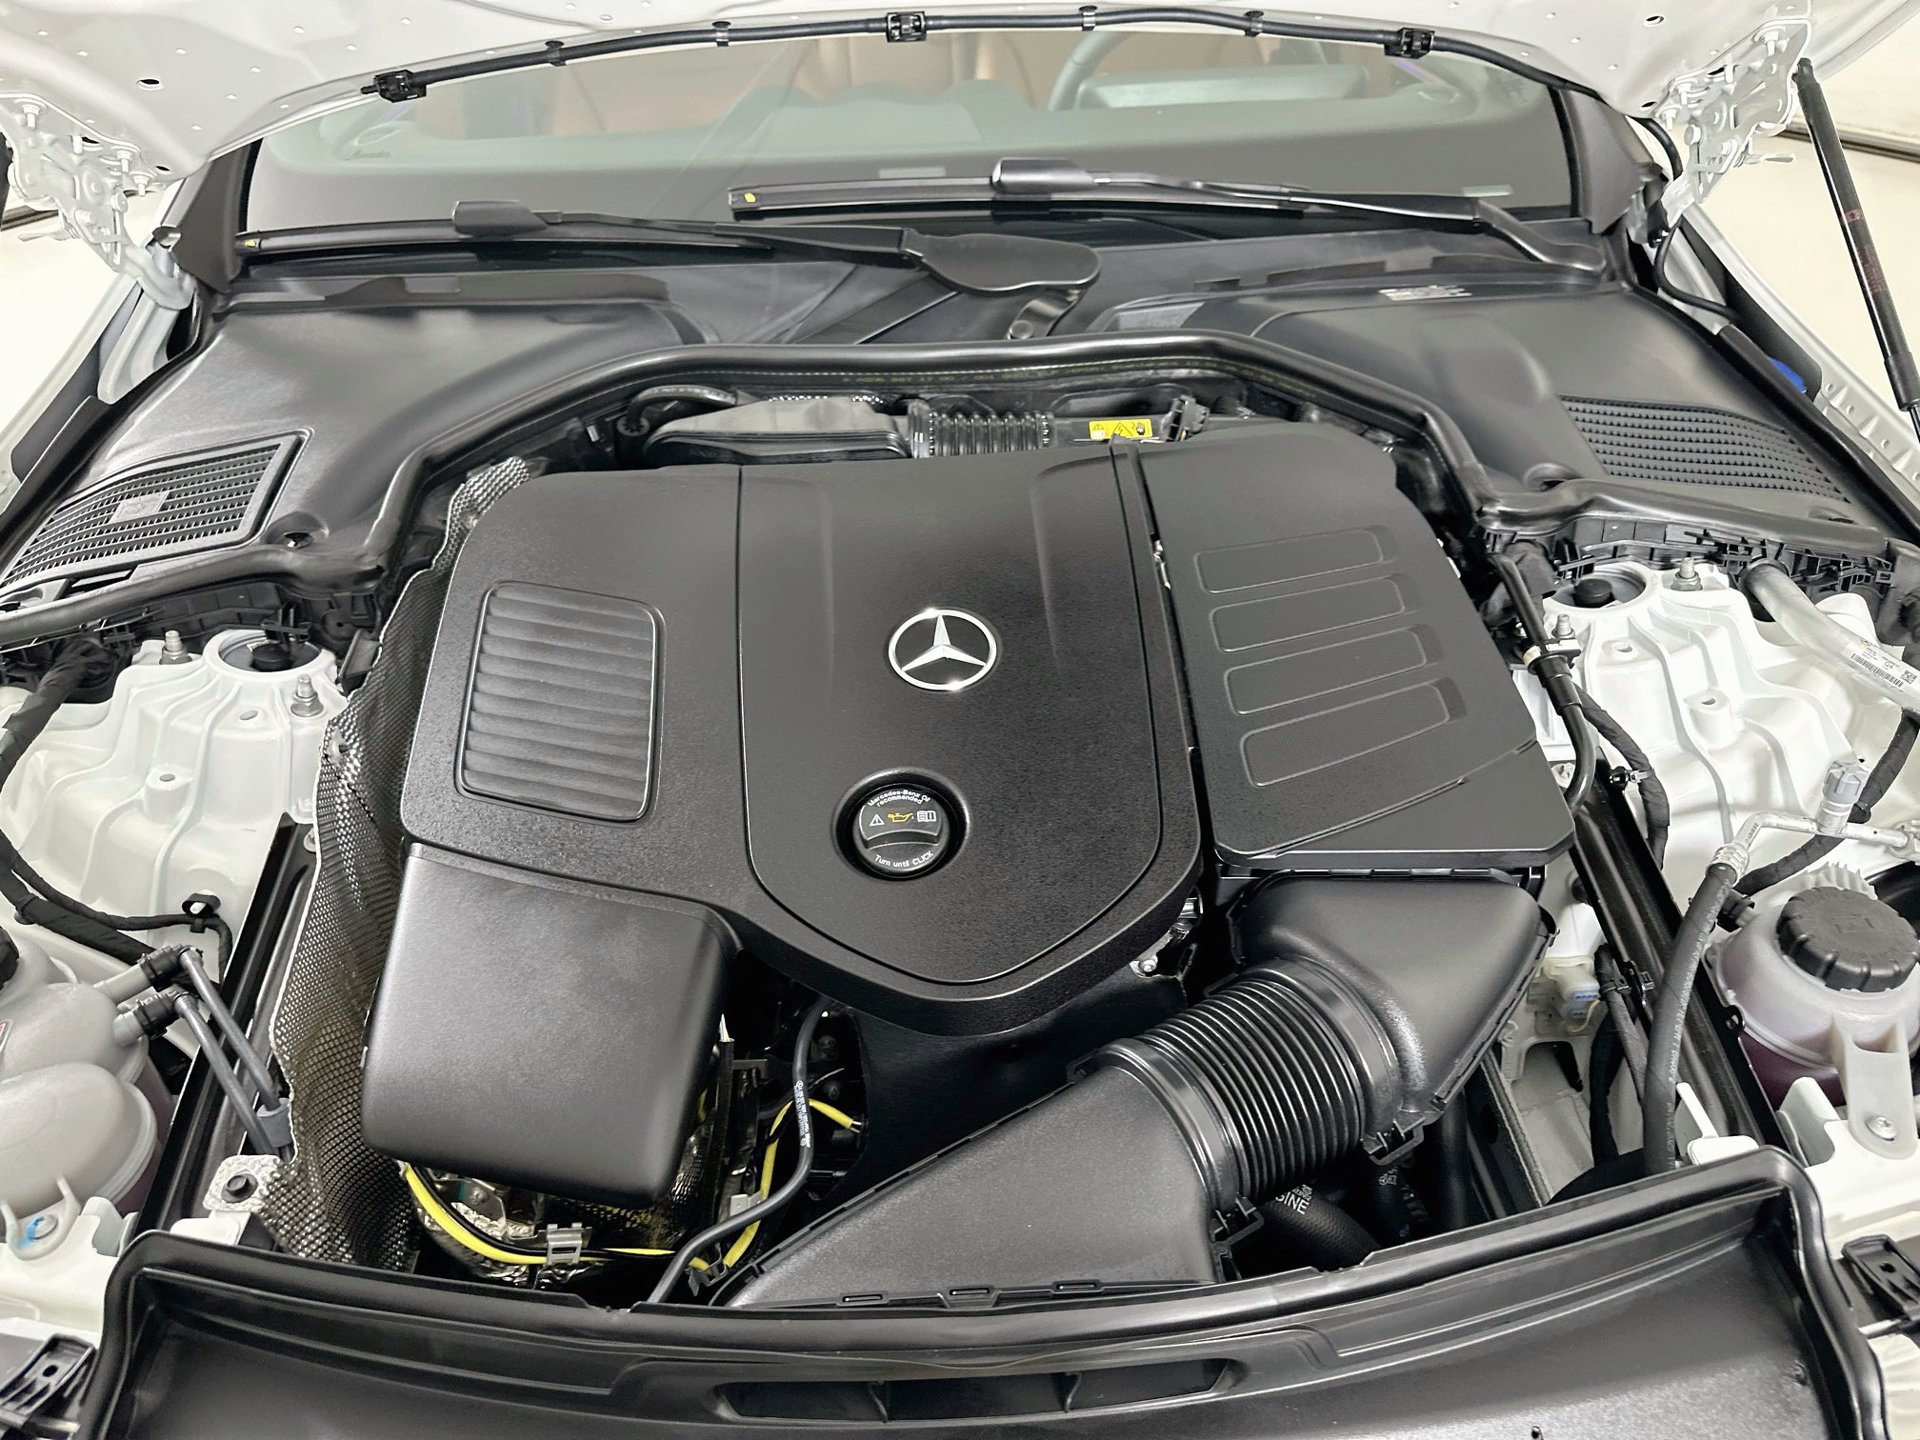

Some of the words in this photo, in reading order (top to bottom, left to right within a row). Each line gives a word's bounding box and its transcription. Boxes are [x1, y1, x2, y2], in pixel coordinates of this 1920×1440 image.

[867, 790, 920, 806] Mercedes-Benz
[877, 795, 922, 807] recommended
[874, 854, 891, 867] Turn
[912, 850, 934, 865] CLICK
